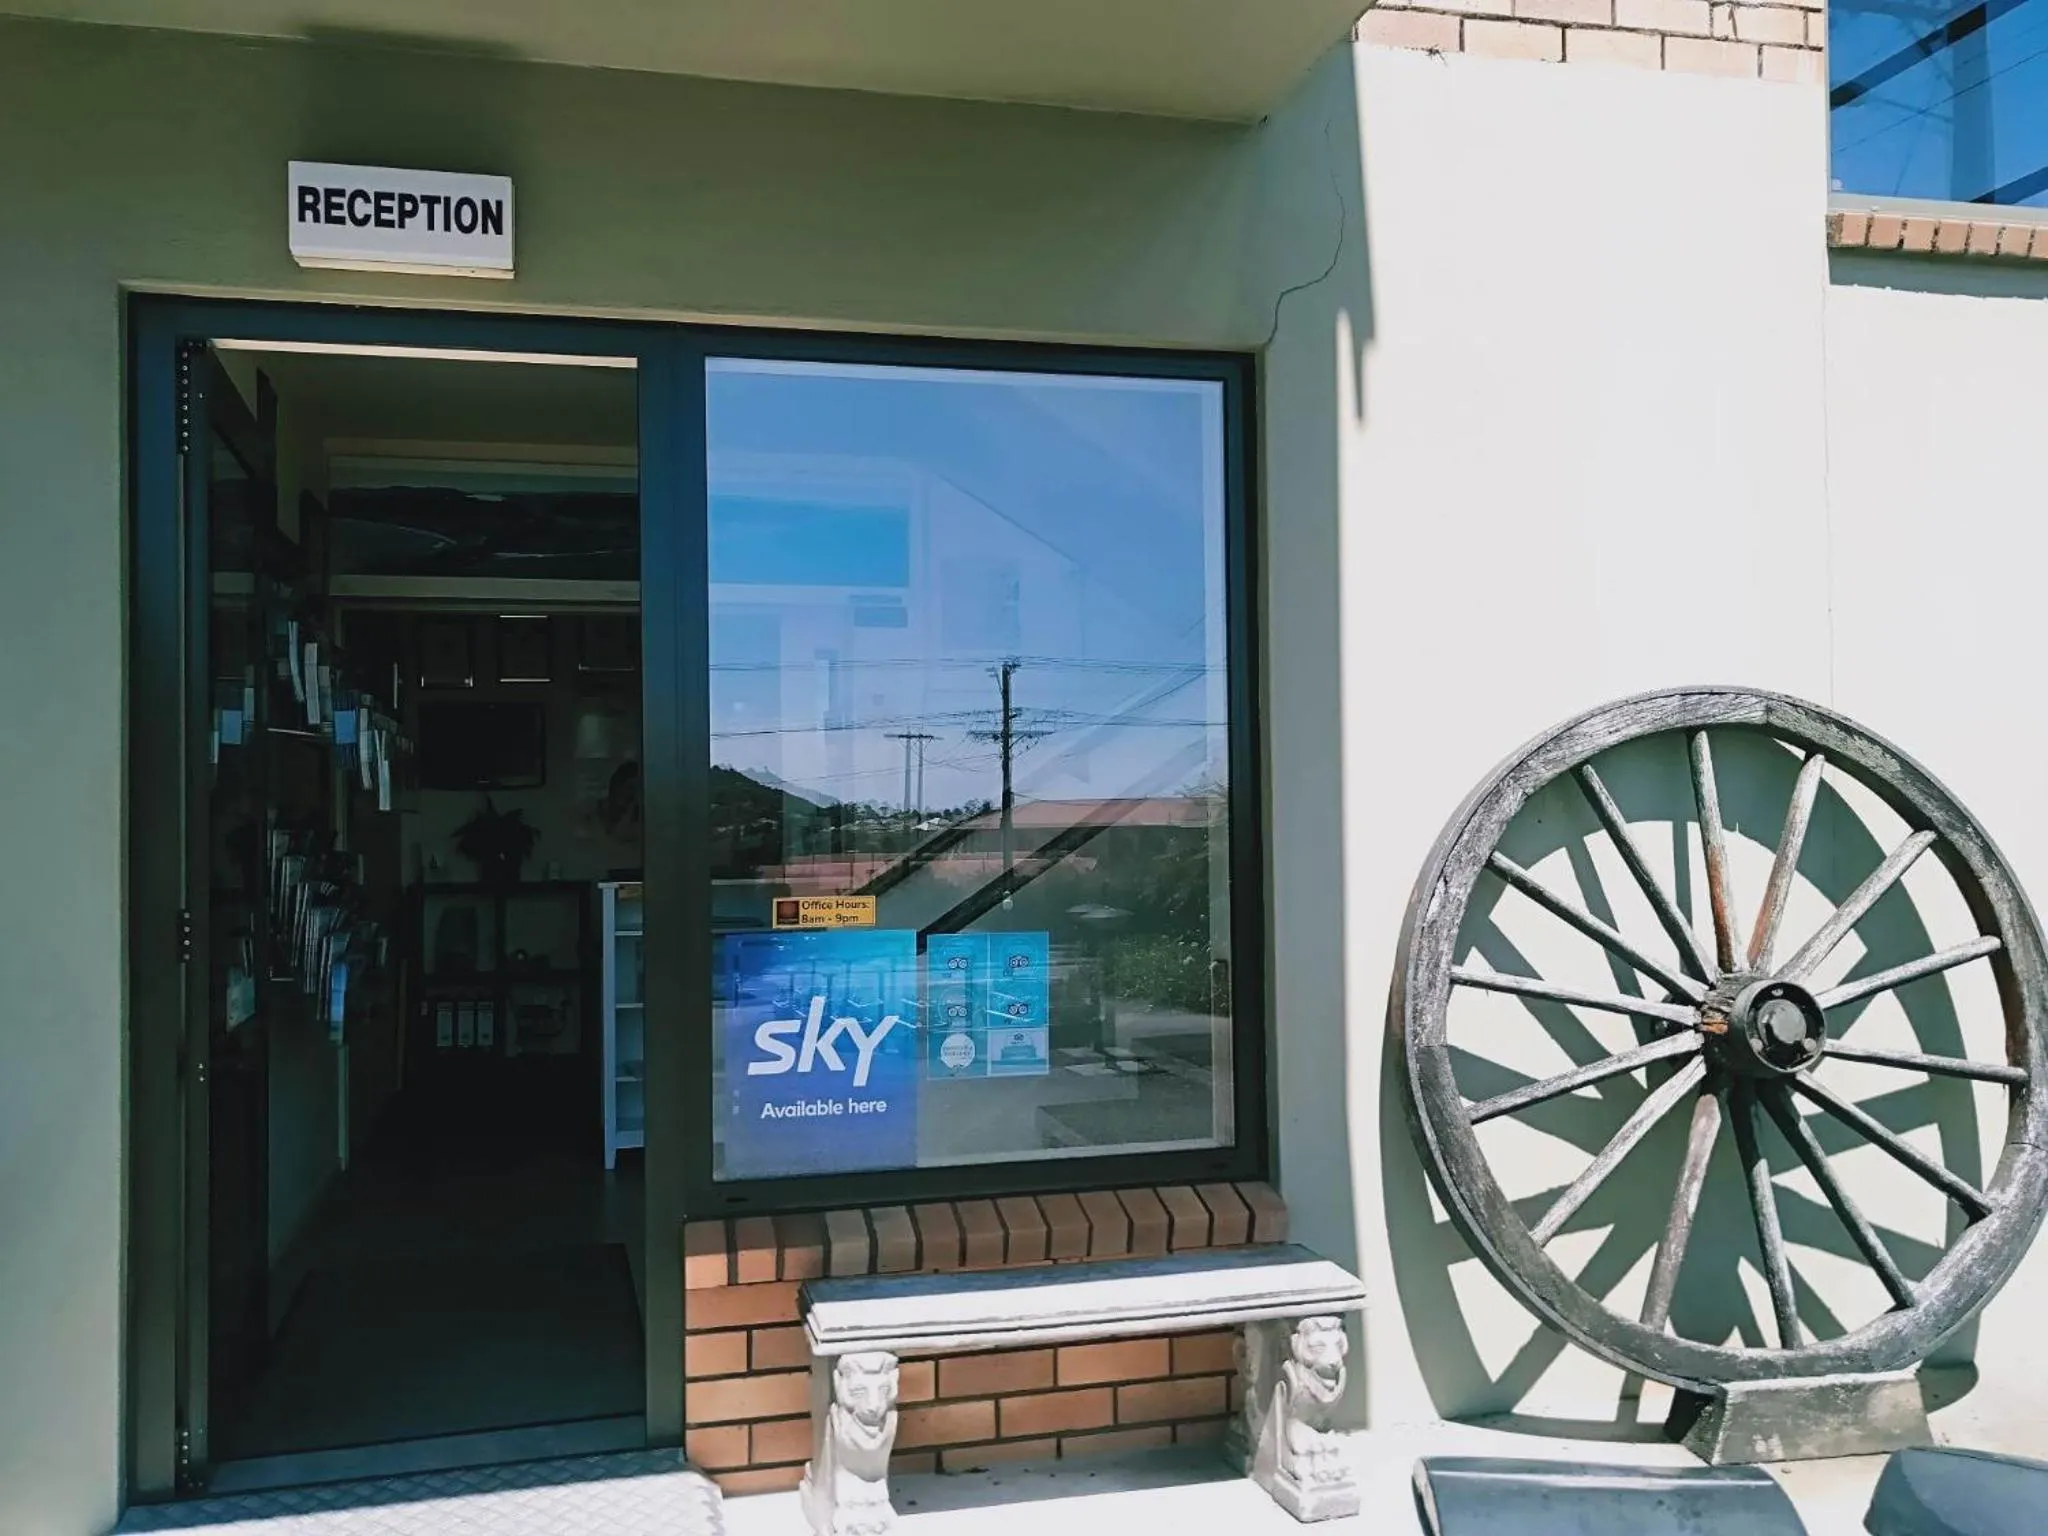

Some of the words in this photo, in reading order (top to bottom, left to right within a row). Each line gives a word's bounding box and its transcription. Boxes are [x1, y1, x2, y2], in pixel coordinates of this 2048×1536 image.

[298, 185, 504, 236] RECEPTION
[802, 901, 833, 910] Office
[802, 914, 825, 924] 8am
[835, 913, 859, 923] 9pm
[761, 1100, 843, 1119] Available
[849, 1099, 888, 1114] here
